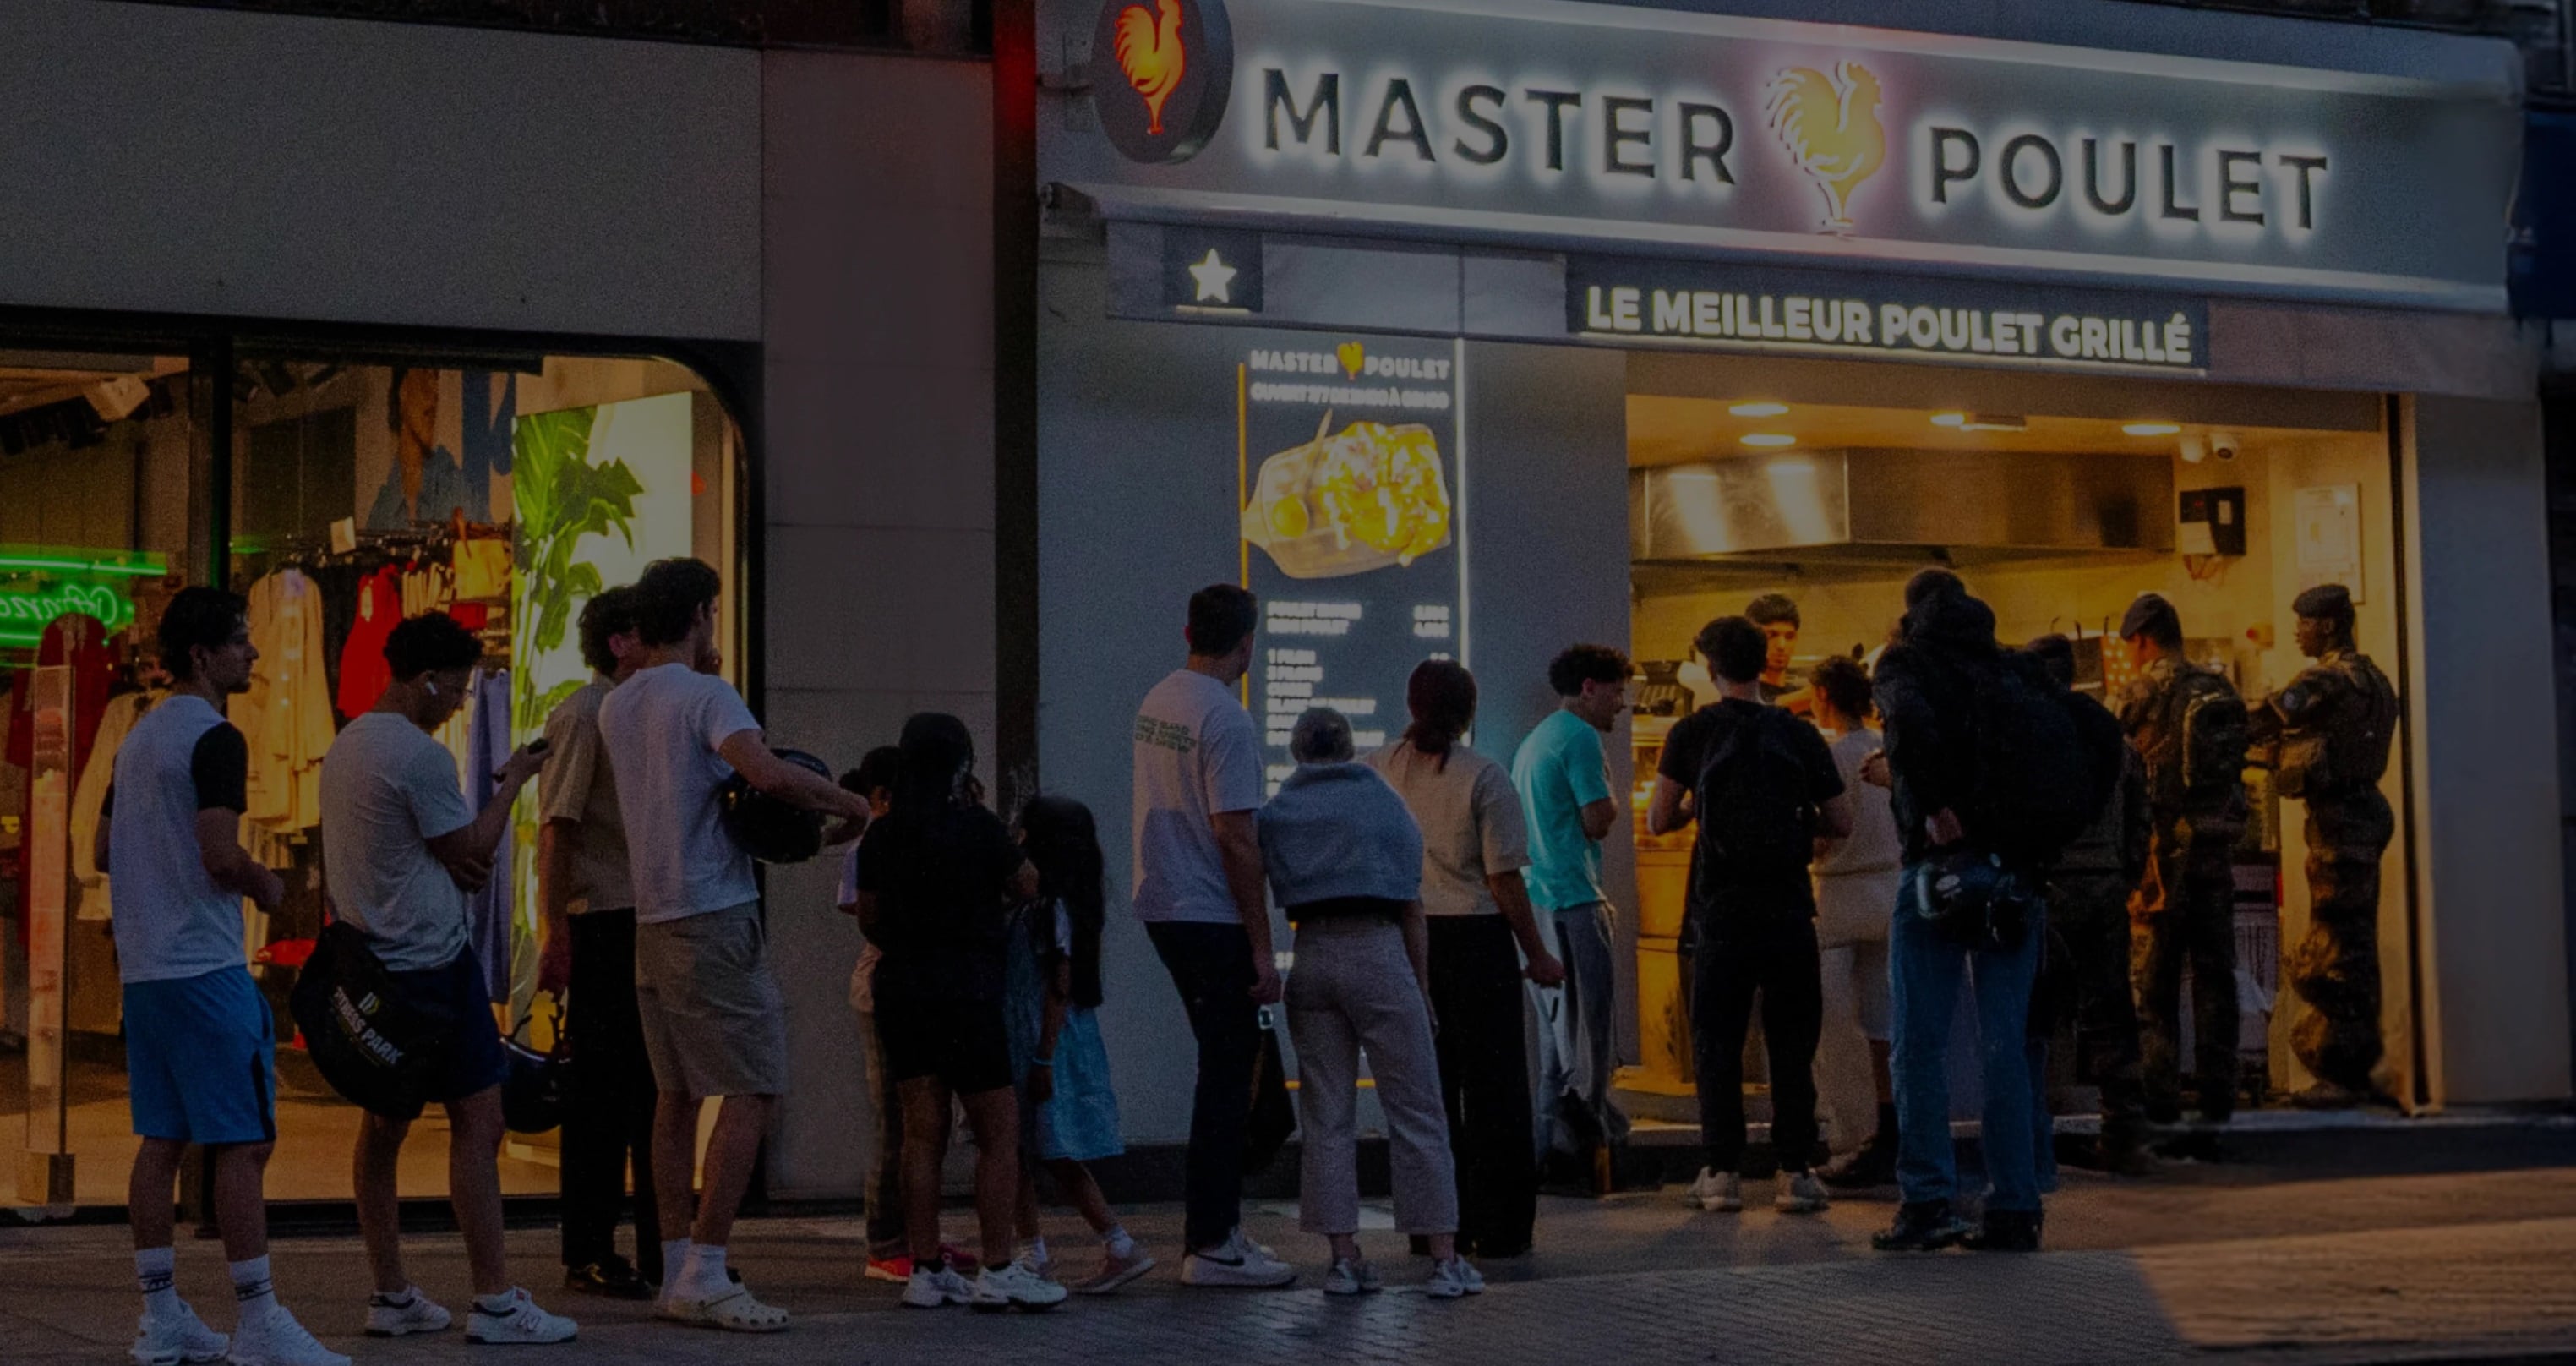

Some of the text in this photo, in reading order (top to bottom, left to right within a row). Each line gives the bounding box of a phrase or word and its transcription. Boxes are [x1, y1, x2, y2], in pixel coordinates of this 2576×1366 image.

[1263, 66, 2328, 230] MASTER POULET
[1587, 286, 2191, 363] LE MEILLEUR POULET GRILLÉ
[1250, 349, 1450, 380] MASTER POULET
[361, 1027, 404, 1065] PARK
